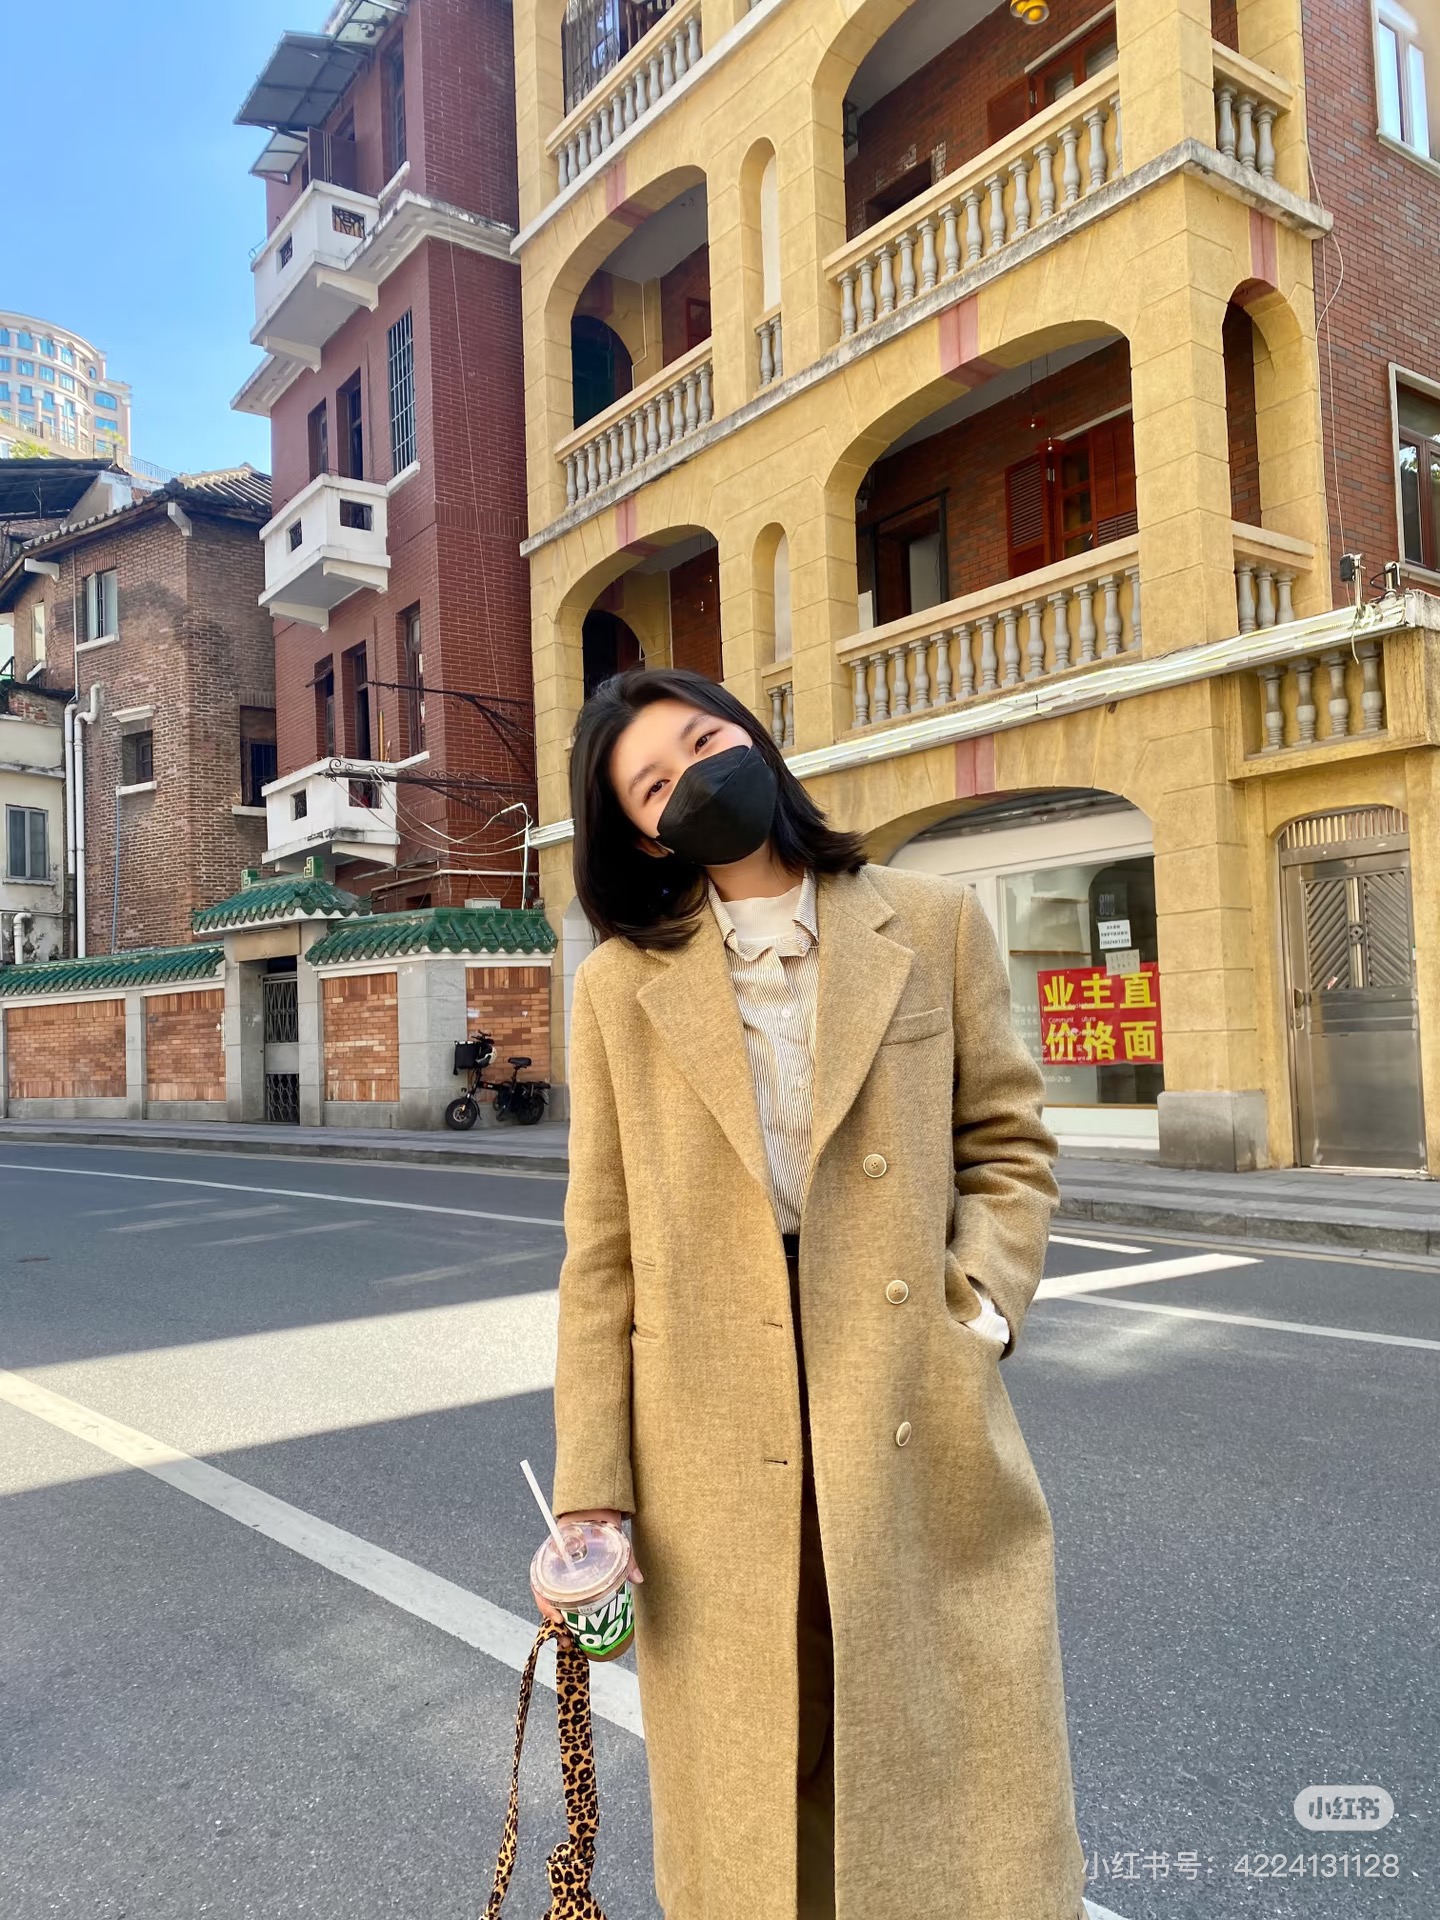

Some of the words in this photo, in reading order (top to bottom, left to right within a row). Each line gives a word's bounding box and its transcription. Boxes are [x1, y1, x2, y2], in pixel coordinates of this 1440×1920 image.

[1043, 971, 1157, 1012] 业主直
[1045, 1020, 1157, 1061] 价格面
